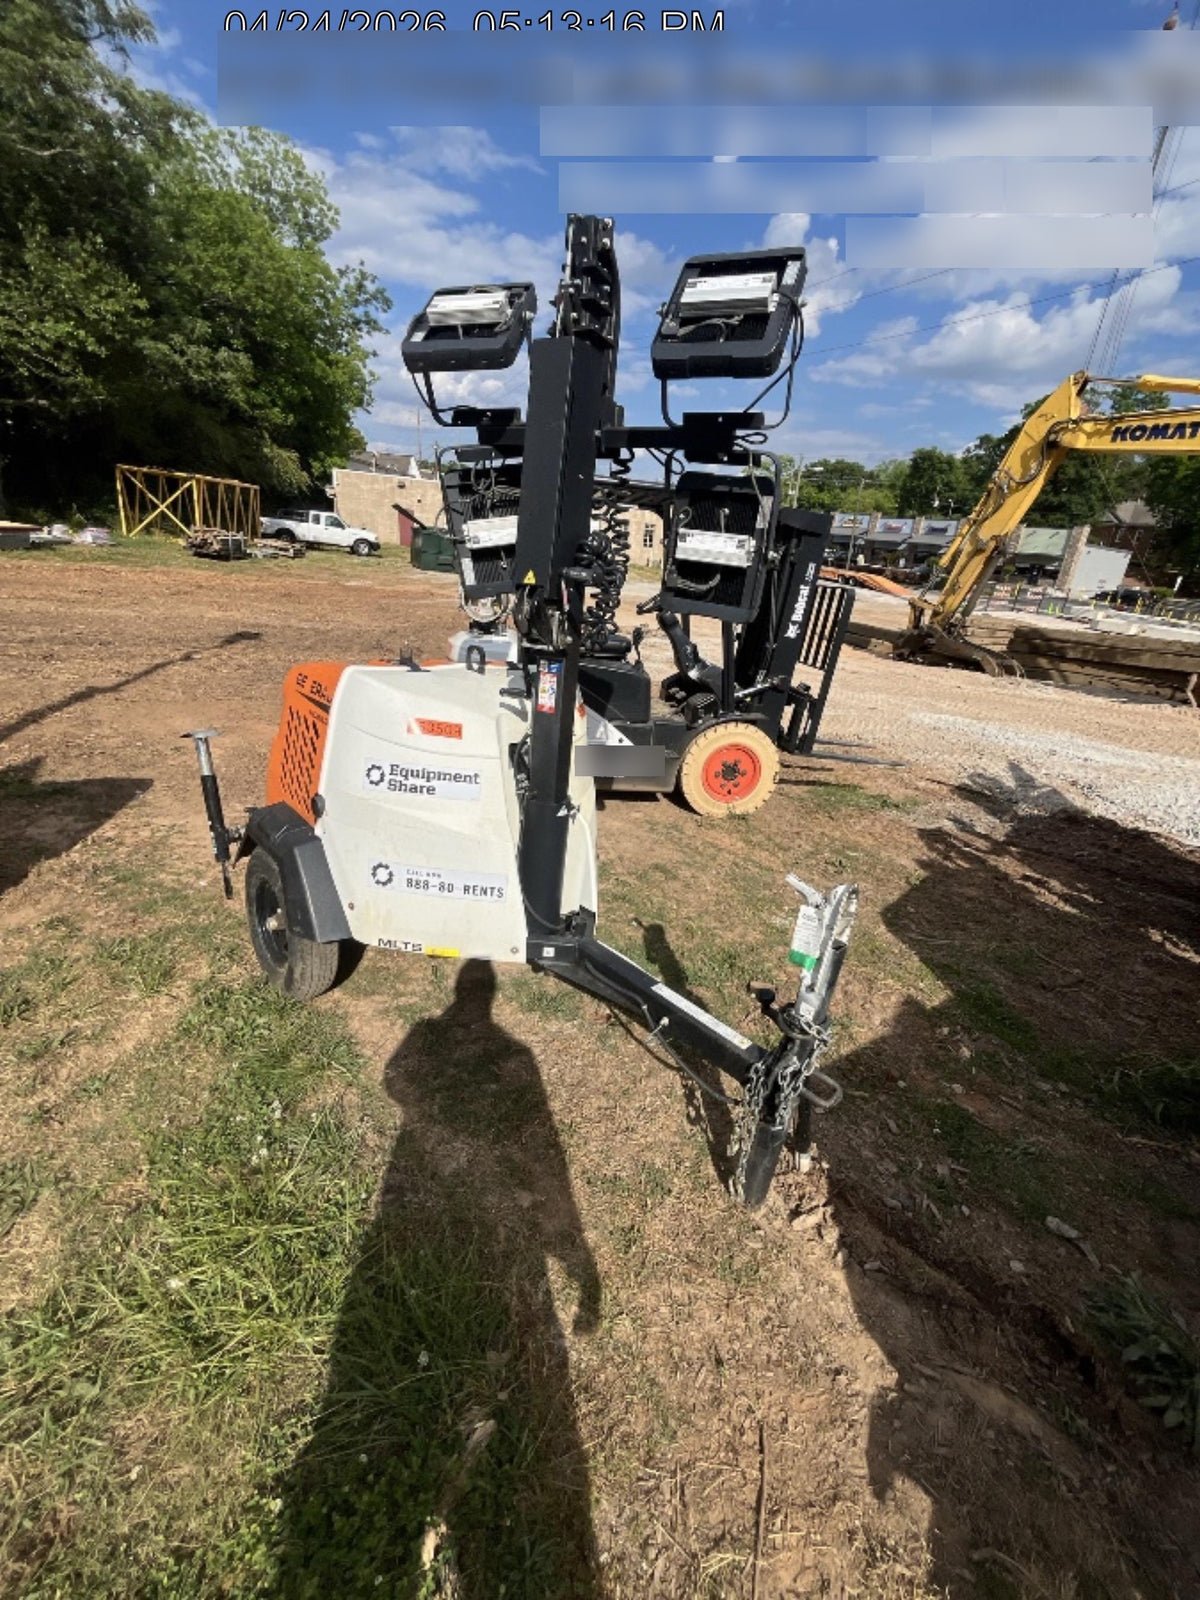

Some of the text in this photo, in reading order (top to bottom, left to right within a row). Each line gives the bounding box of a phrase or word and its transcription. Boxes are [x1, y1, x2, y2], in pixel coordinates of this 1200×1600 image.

[388, 763, 480, 785] Equipment
[387, 778, 436, 795] Share
[463, 884, 504, 898] RENTS
